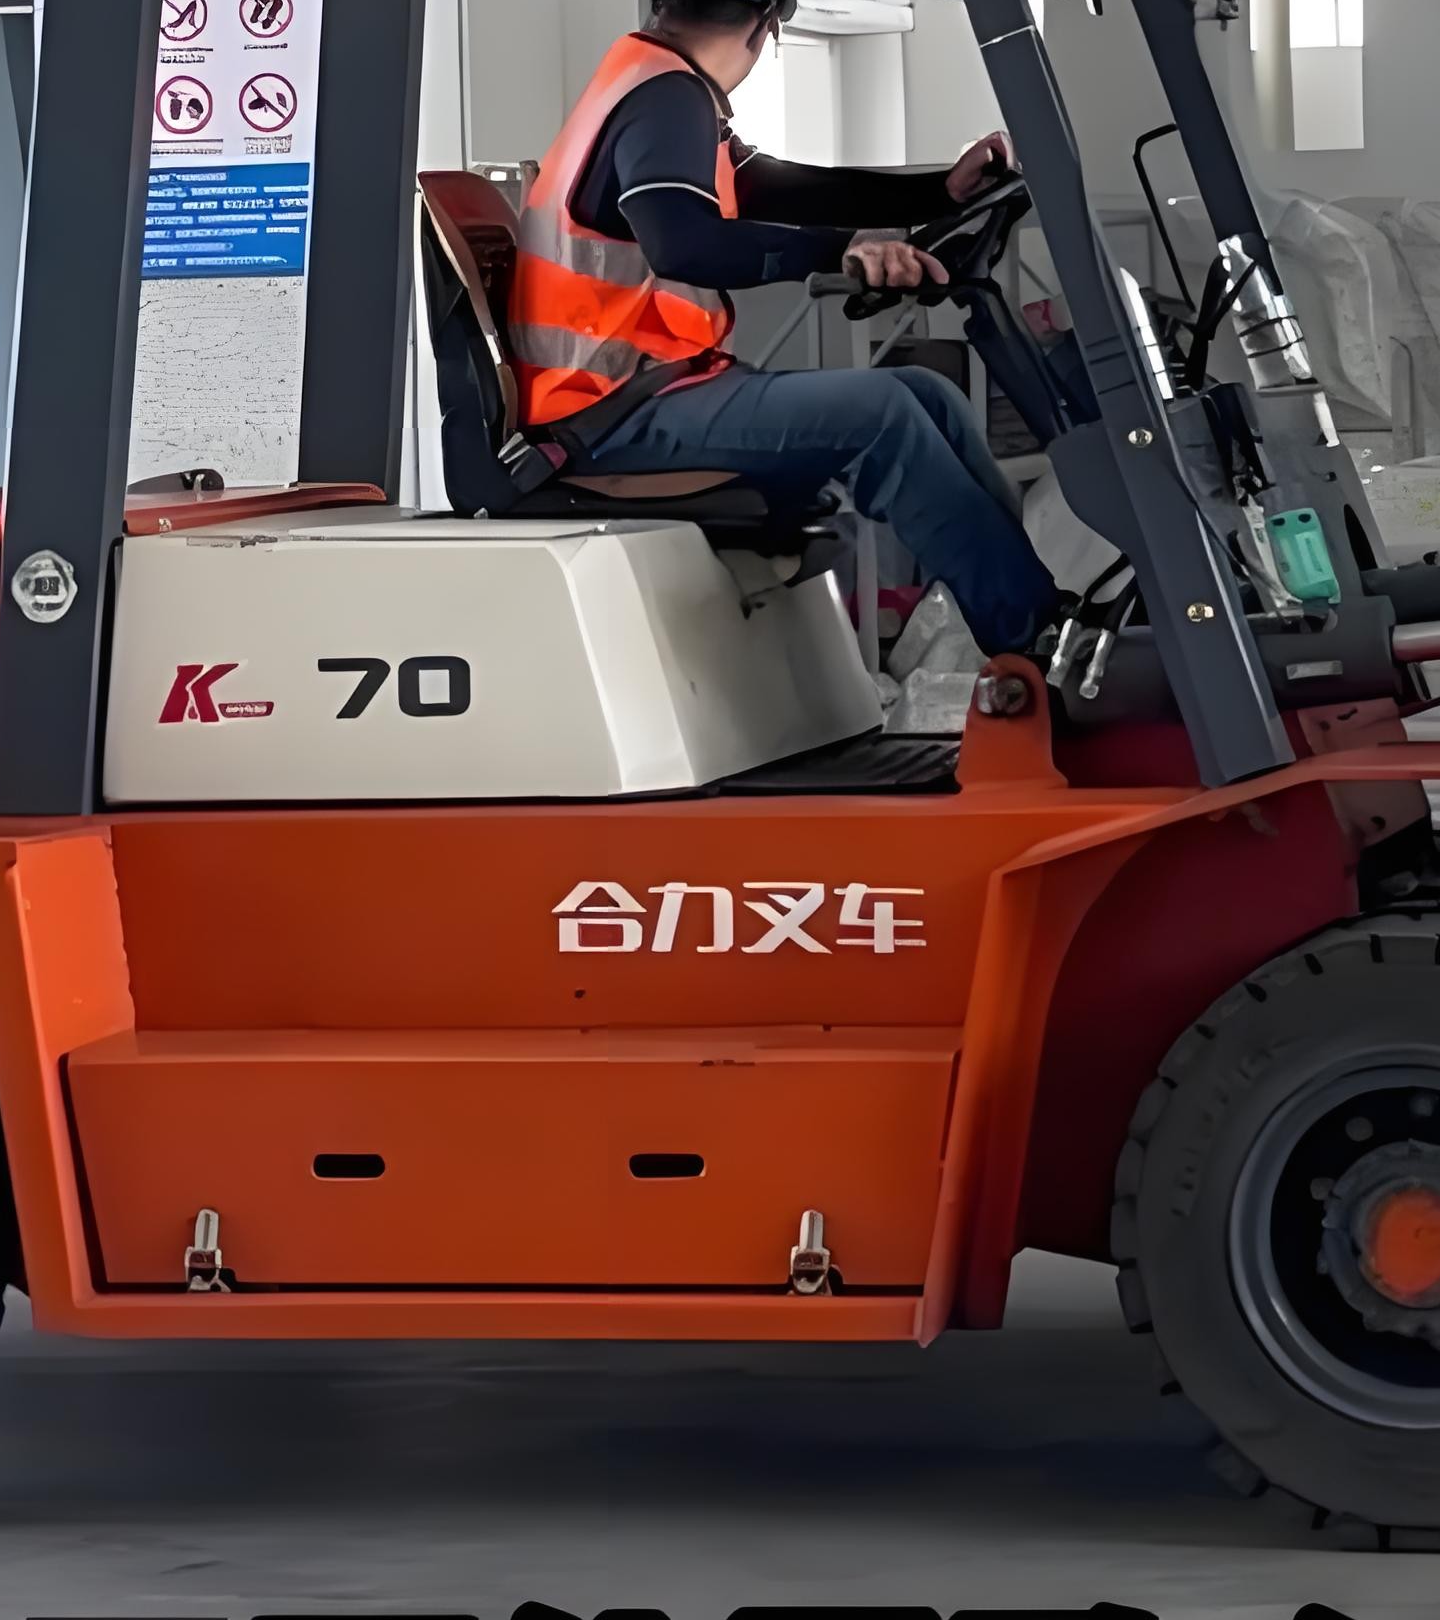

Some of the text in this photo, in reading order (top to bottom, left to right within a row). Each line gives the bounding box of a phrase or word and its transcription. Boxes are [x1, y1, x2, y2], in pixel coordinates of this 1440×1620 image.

[317, 656, 471, 719] 70
[552, 882, 927, 954] 合力叉车
